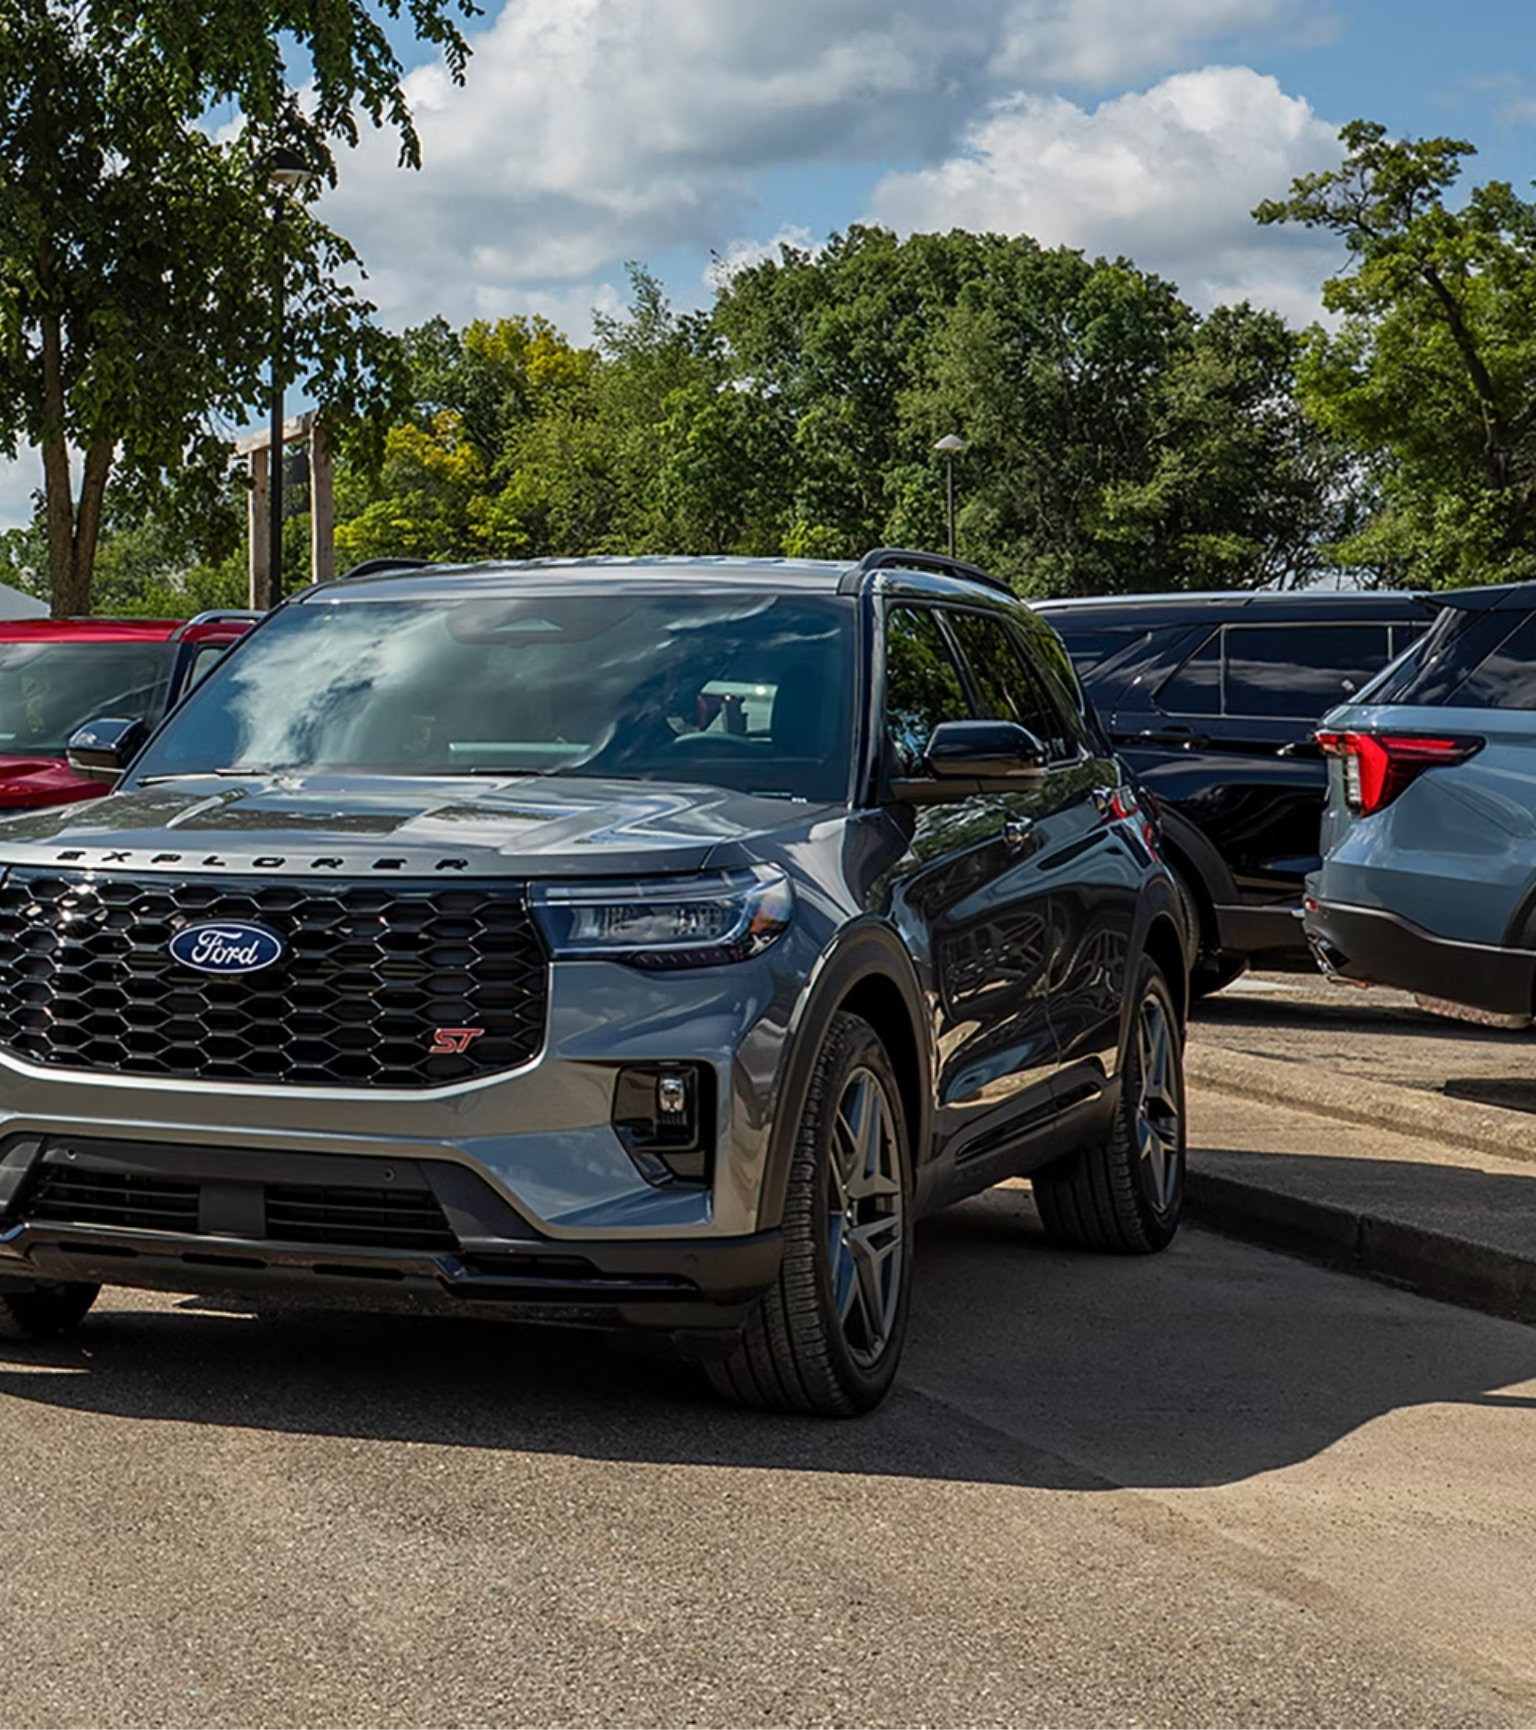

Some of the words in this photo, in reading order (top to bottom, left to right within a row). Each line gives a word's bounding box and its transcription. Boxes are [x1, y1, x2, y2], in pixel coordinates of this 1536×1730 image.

[56, 850, 470, 871] EXPLORER
[191, 929, 259, 965] Ford
[429, 1028, 485, 1053] ST
